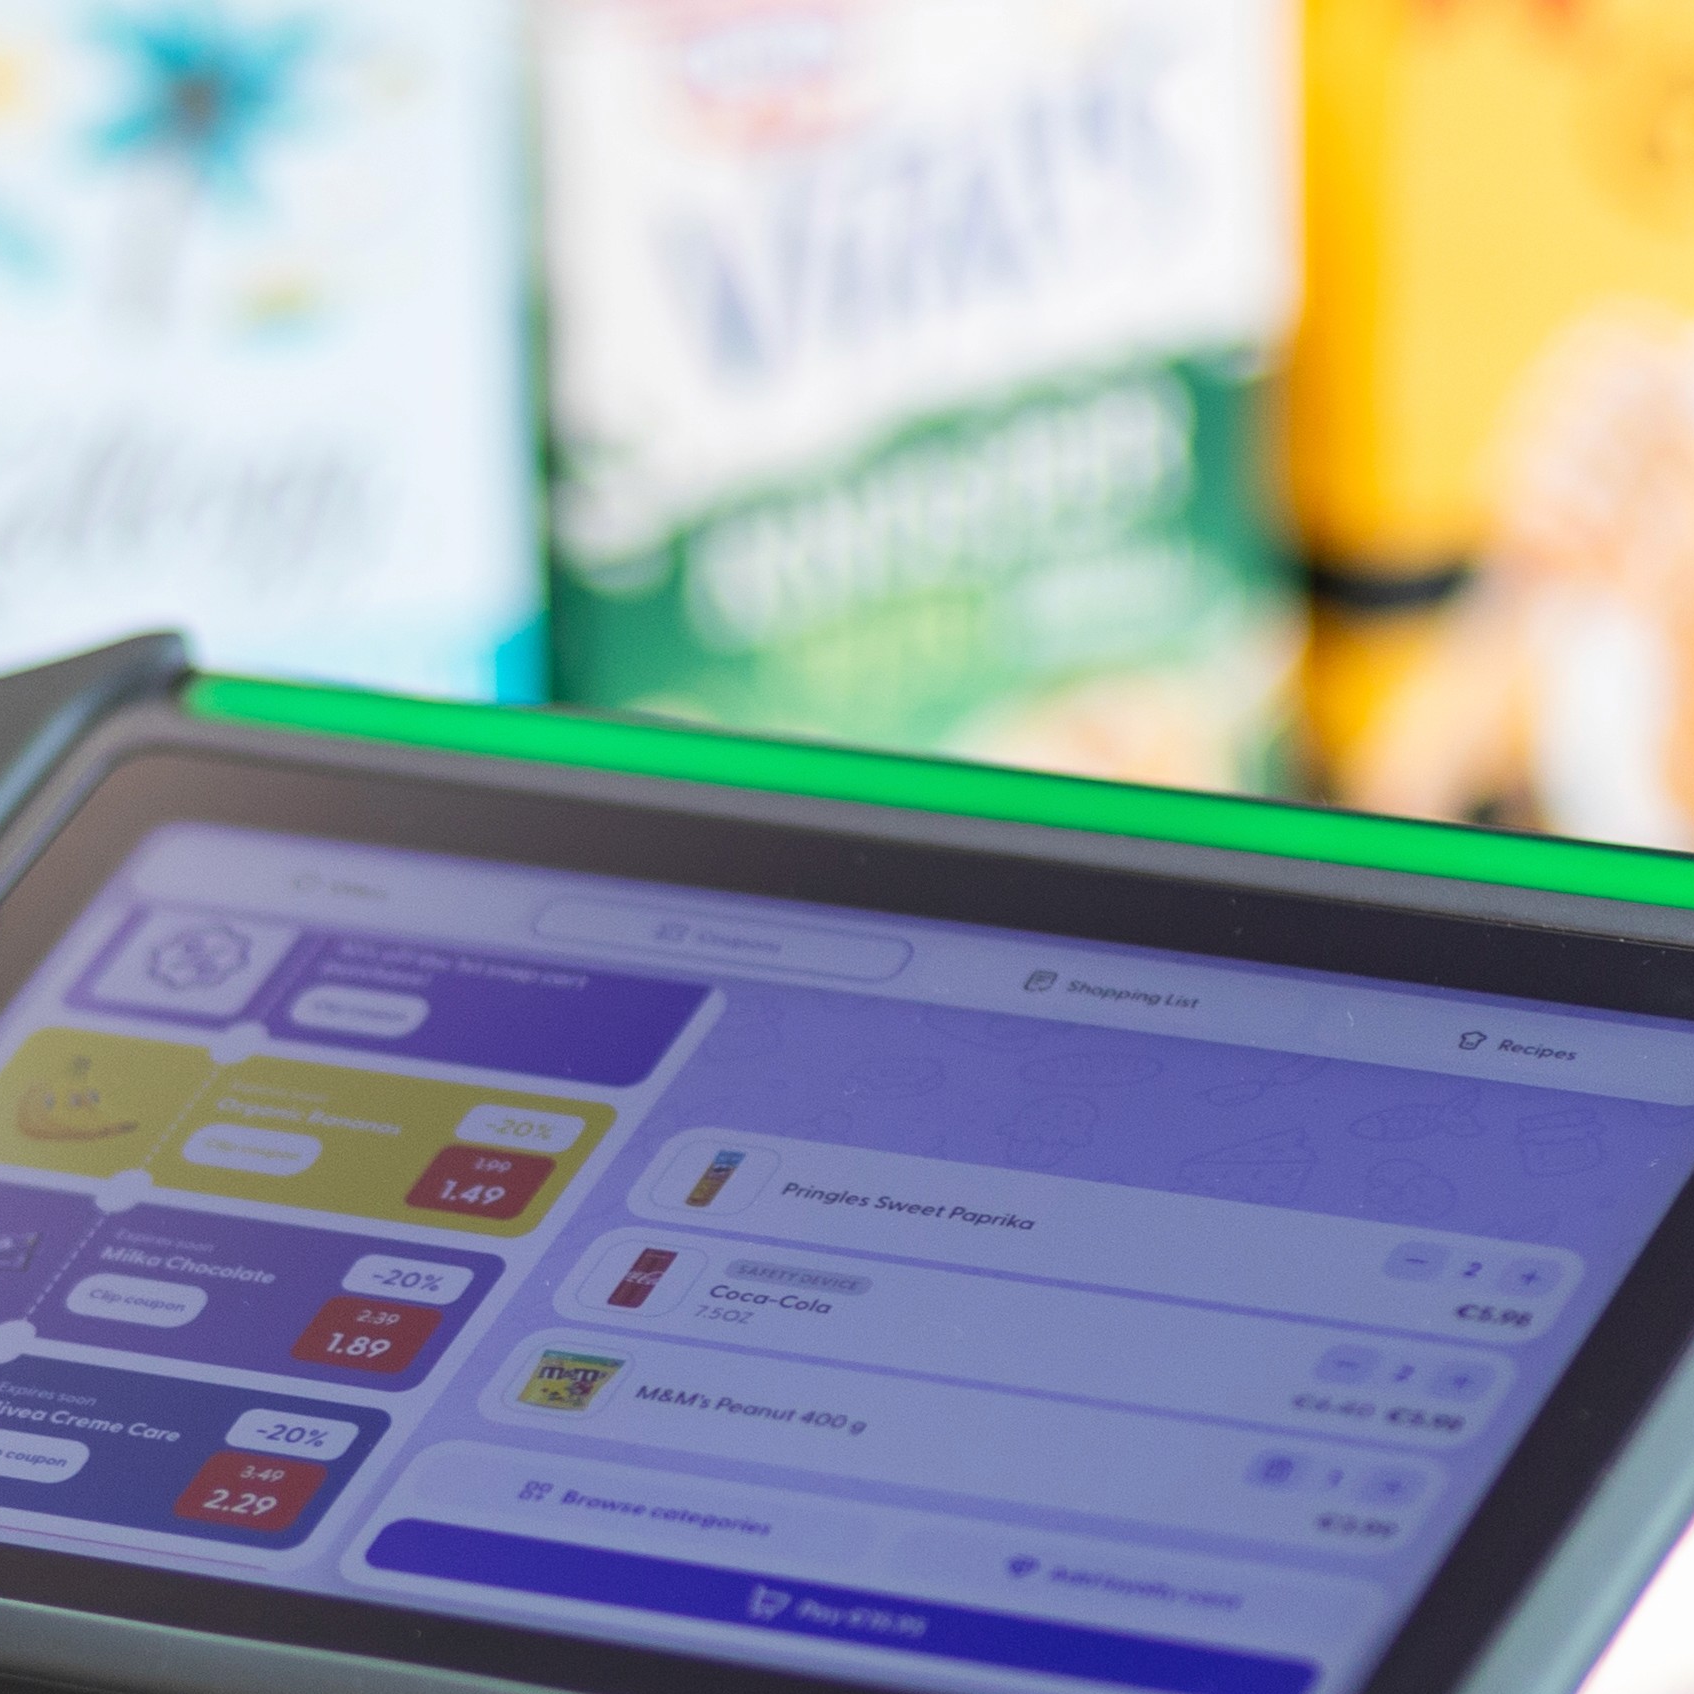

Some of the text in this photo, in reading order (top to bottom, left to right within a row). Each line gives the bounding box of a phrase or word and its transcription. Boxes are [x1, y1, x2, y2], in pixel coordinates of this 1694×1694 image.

[1066, 980, 1200, 1011] Shopping List
[1497, 1038, 1577, 1062] Recipes
[216, 1097, 404, 1138] Organic Bananas
[485, 1117, 555, 1142] -20%
[439, 1179, 507, 1206] 1.49
[780, 1181, 1036, 1232] Pringles Sweet Paprika
[100, 1245, 277, 1285] Milka Chocolate
[737, 1263, 861, 1292] SAFETY DEVICE
[372, 1269, 445, 1293] -20%
[124, 1294, 187, 1315] coupon
[708, 1283, 834, 1315] Coca-Cola
[325, 1332, 392, 1359] 1.89
[57, 1392, 98, 1407] soon
[635, 1384, 868, 1438] M&M's Peanut 400 g
[49, 1409, 125, 1436] Creme
[127, 1421, 182, 1444] Care
[256, 1424, 329, 1449] -20%
[3, 1448, 69, 1469] coupon
[203, 1488, 278, 1518] 2.29
[560, 1488, 772, 1537] Browse categories
